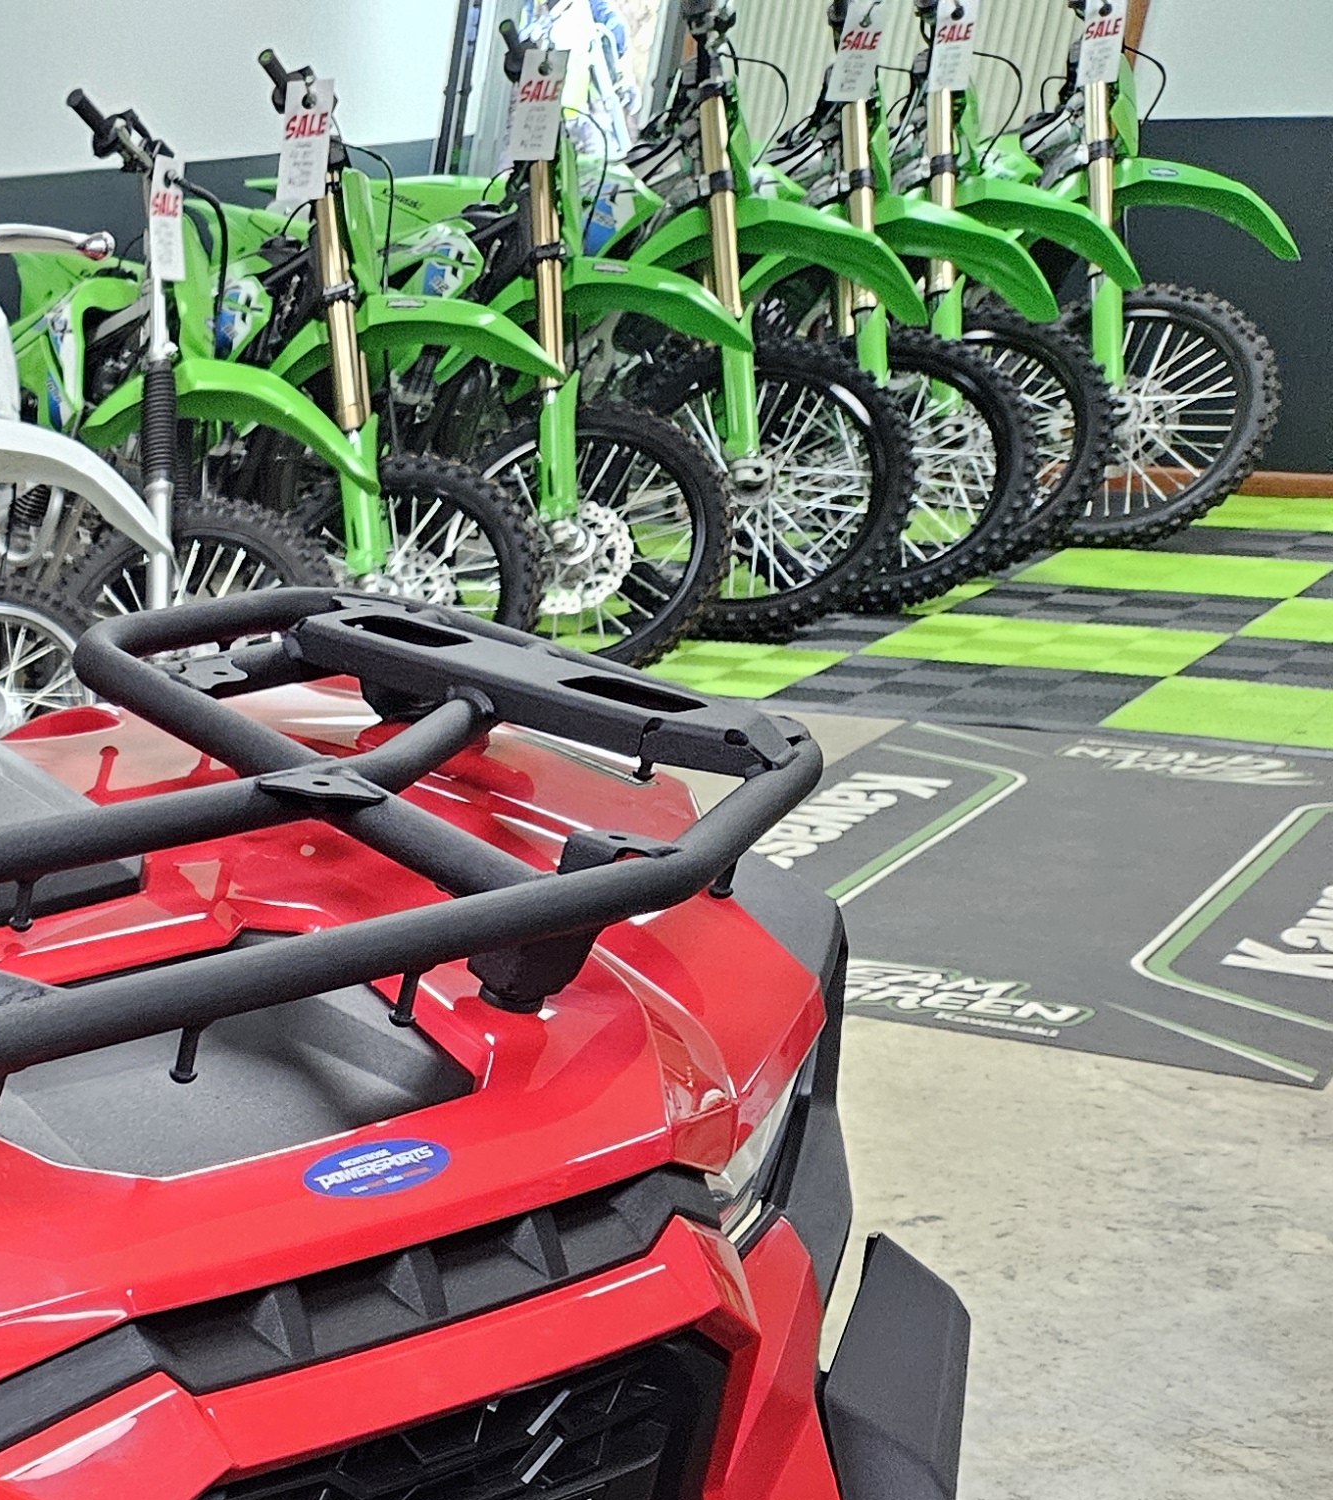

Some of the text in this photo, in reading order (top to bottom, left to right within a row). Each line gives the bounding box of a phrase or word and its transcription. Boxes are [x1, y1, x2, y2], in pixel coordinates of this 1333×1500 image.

[841, 31, 882, 51] SALE
[937, 23, 974, 44] SALE
[1081, 18, 1122, 40] SALE
[519, 80, 564, 103] SALE
[285, 112, 328, 140] SALE
[152, 192, 179, 218] SALE
[934, 1011, 1061, 1038] Kawasaki
[313, 1145, 435, 1191] POWERSPORTS
